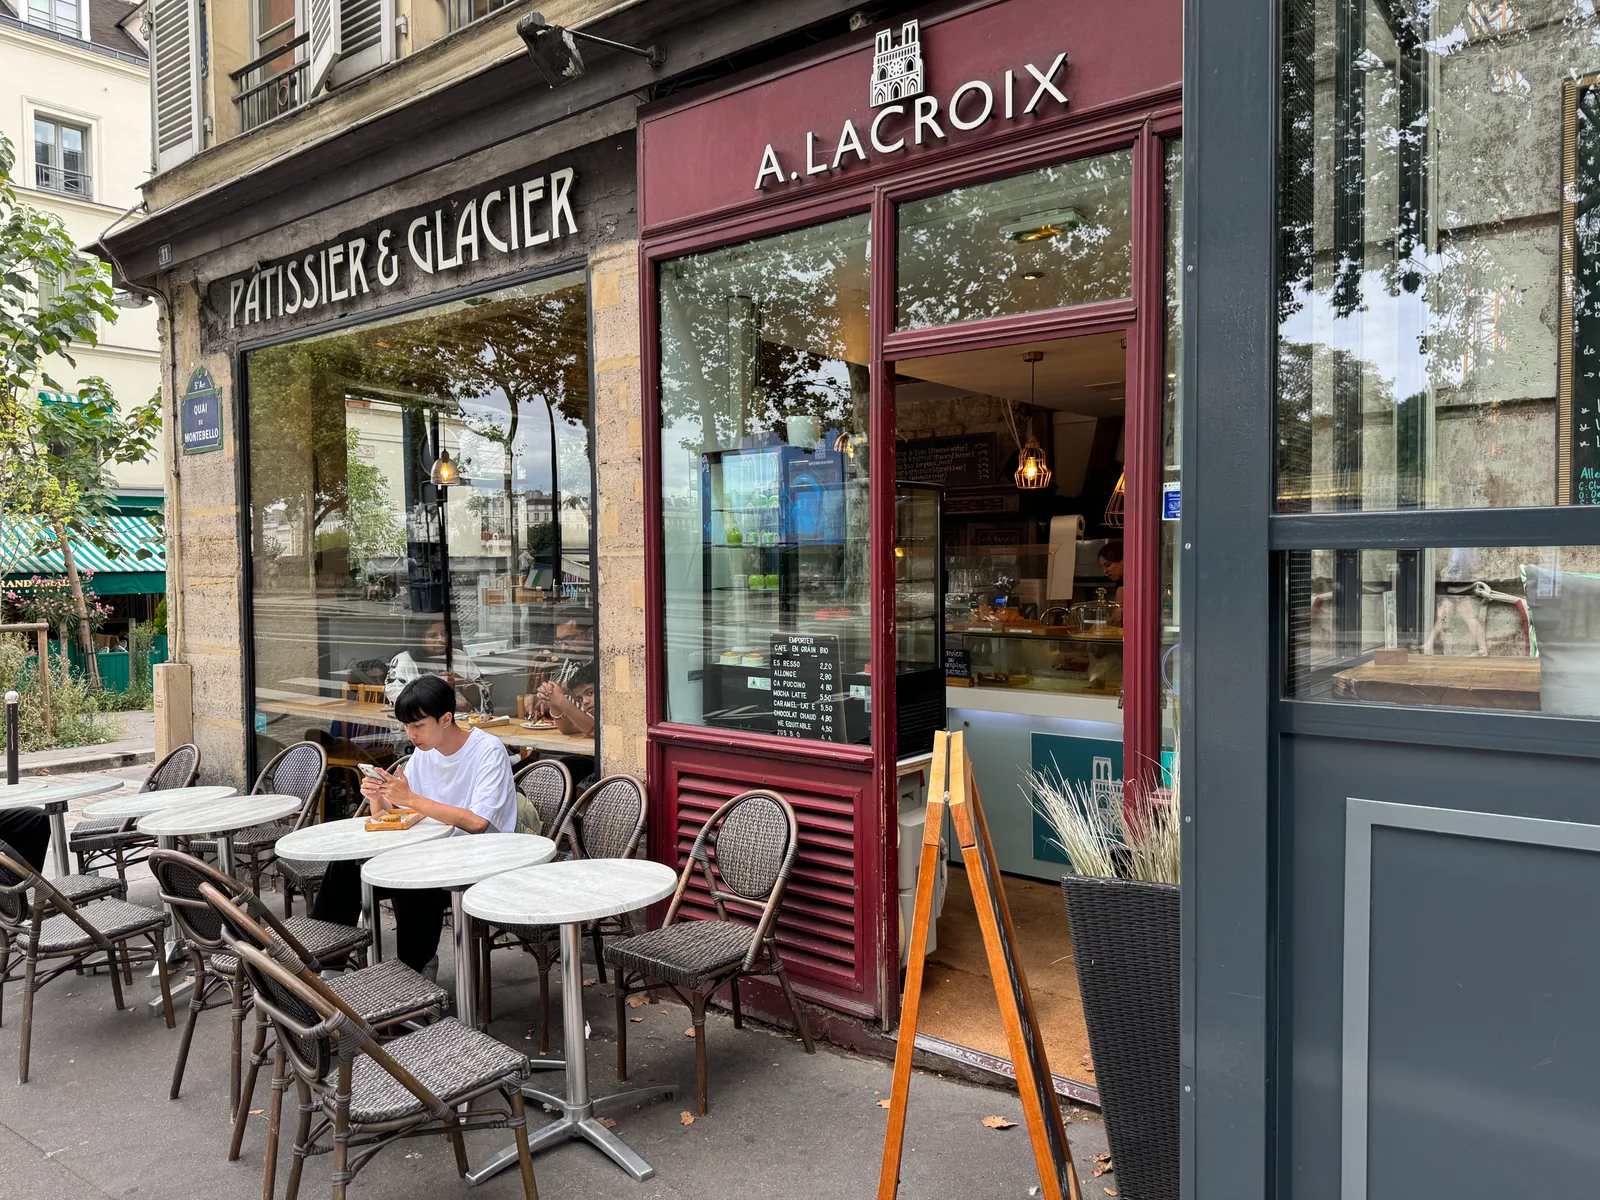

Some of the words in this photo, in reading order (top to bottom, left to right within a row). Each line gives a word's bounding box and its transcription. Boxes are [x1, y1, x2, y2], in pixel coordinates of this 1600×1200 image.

[377, 229, 399, 287] &
[407, 166, 579, 275] GLACIER
[161, 247, 169, 262] 11
[193, 403, 208, 416] QUAI
[184, 427, 219, 443] MONTEBELLO
[1580, 467, 1600, 480] Alle
[0, 579, 33, 589] RAND
[788, 636, 814, 645] EMPORTER
[774, 644, 788, 652] CAFE
[791, 645, 799, 653] EN
[819, 646, 829, 655] BIO
[772, 689, 790, 698] MOCHA
[791, 691, 807, 700] LATTE
[773, 699, 798, 709] CARAMEL
[773, 709, 798, 719] CHOCOLAT
[799, 712, 817, 721] CHAUD
[785, 720, 812, 731] EQUITABLE
